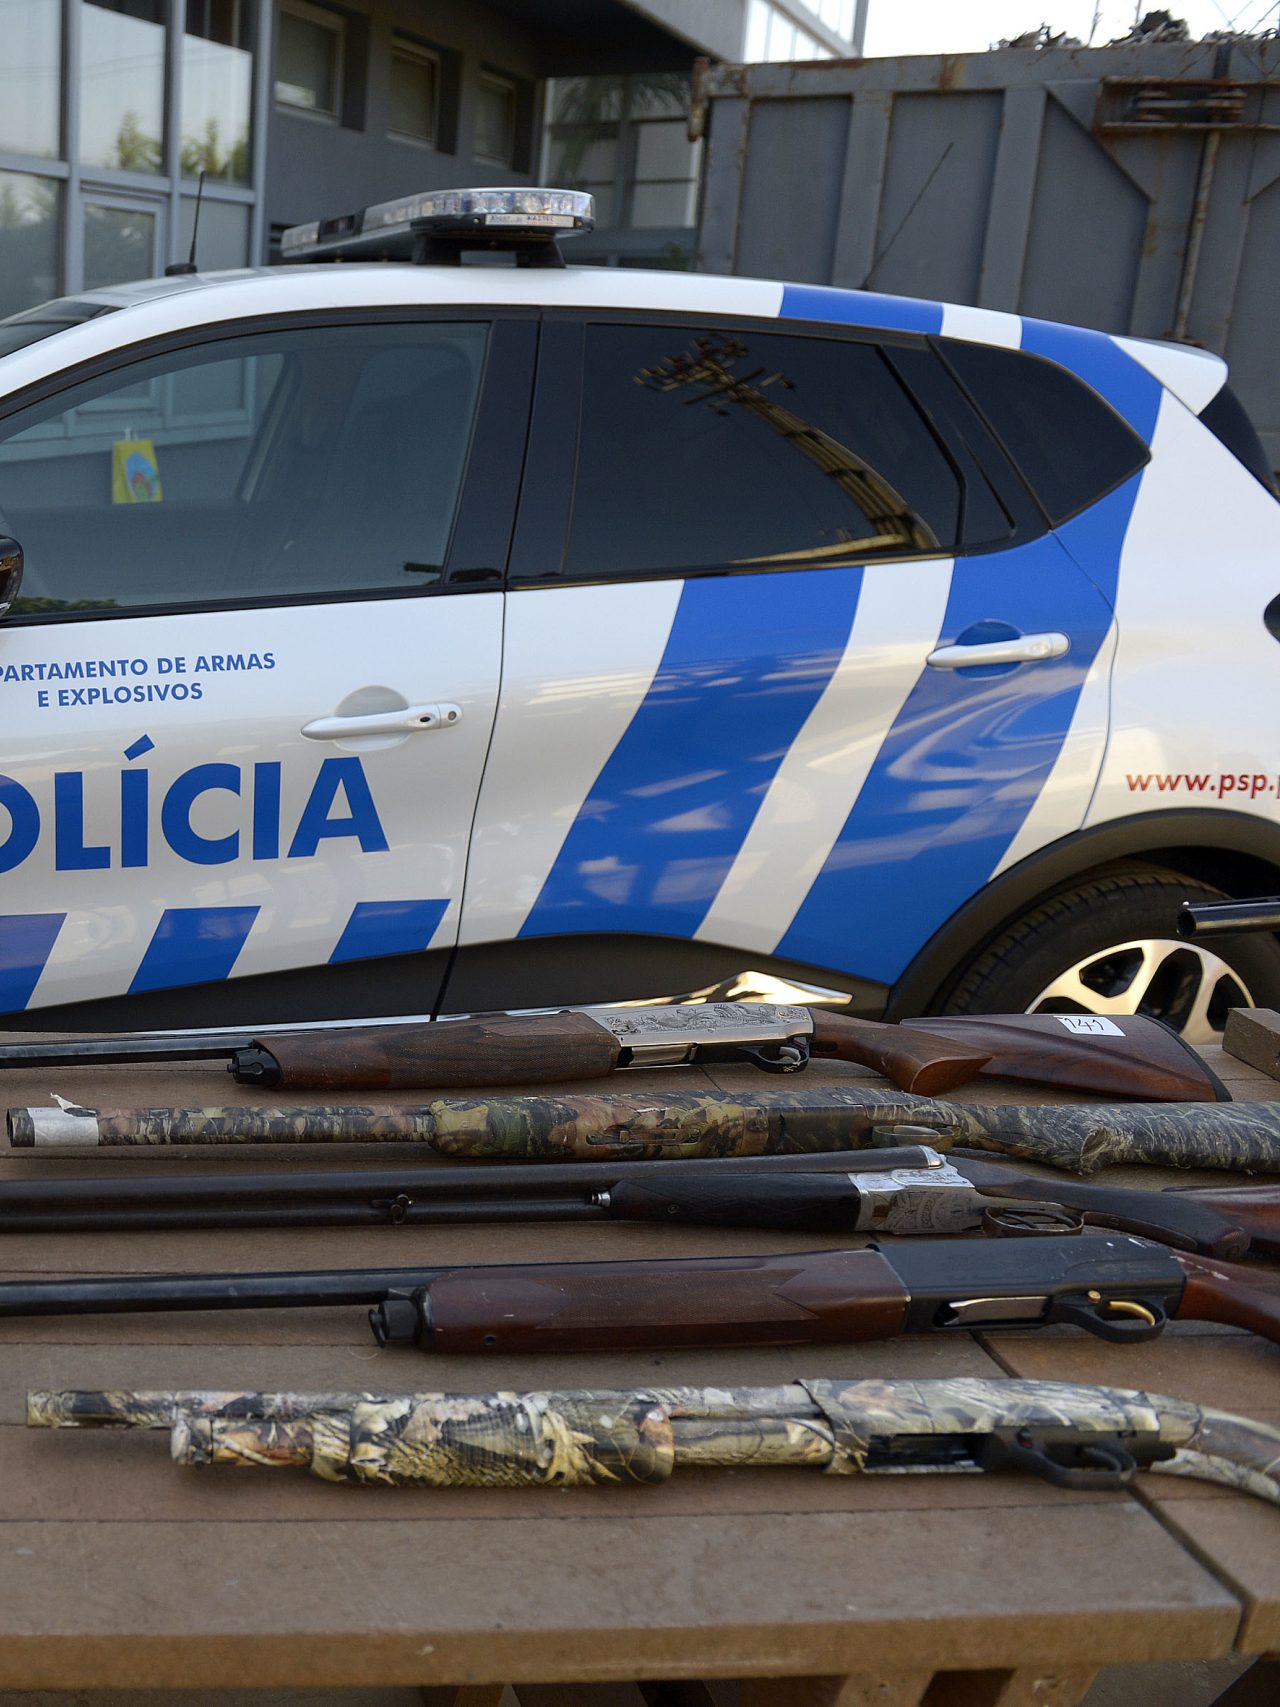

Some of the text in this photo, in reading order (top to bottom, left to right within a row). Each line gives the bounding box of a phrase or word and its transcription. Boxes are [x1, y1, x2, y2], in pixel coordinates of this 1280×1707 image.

[157, 656, 187, 675] DE
[194, 652, 276, 673] ARMAS
[37, 682, 203, 708] E EXPLOSIVOS
[1126, 773, 1280, 799] www.psp.
